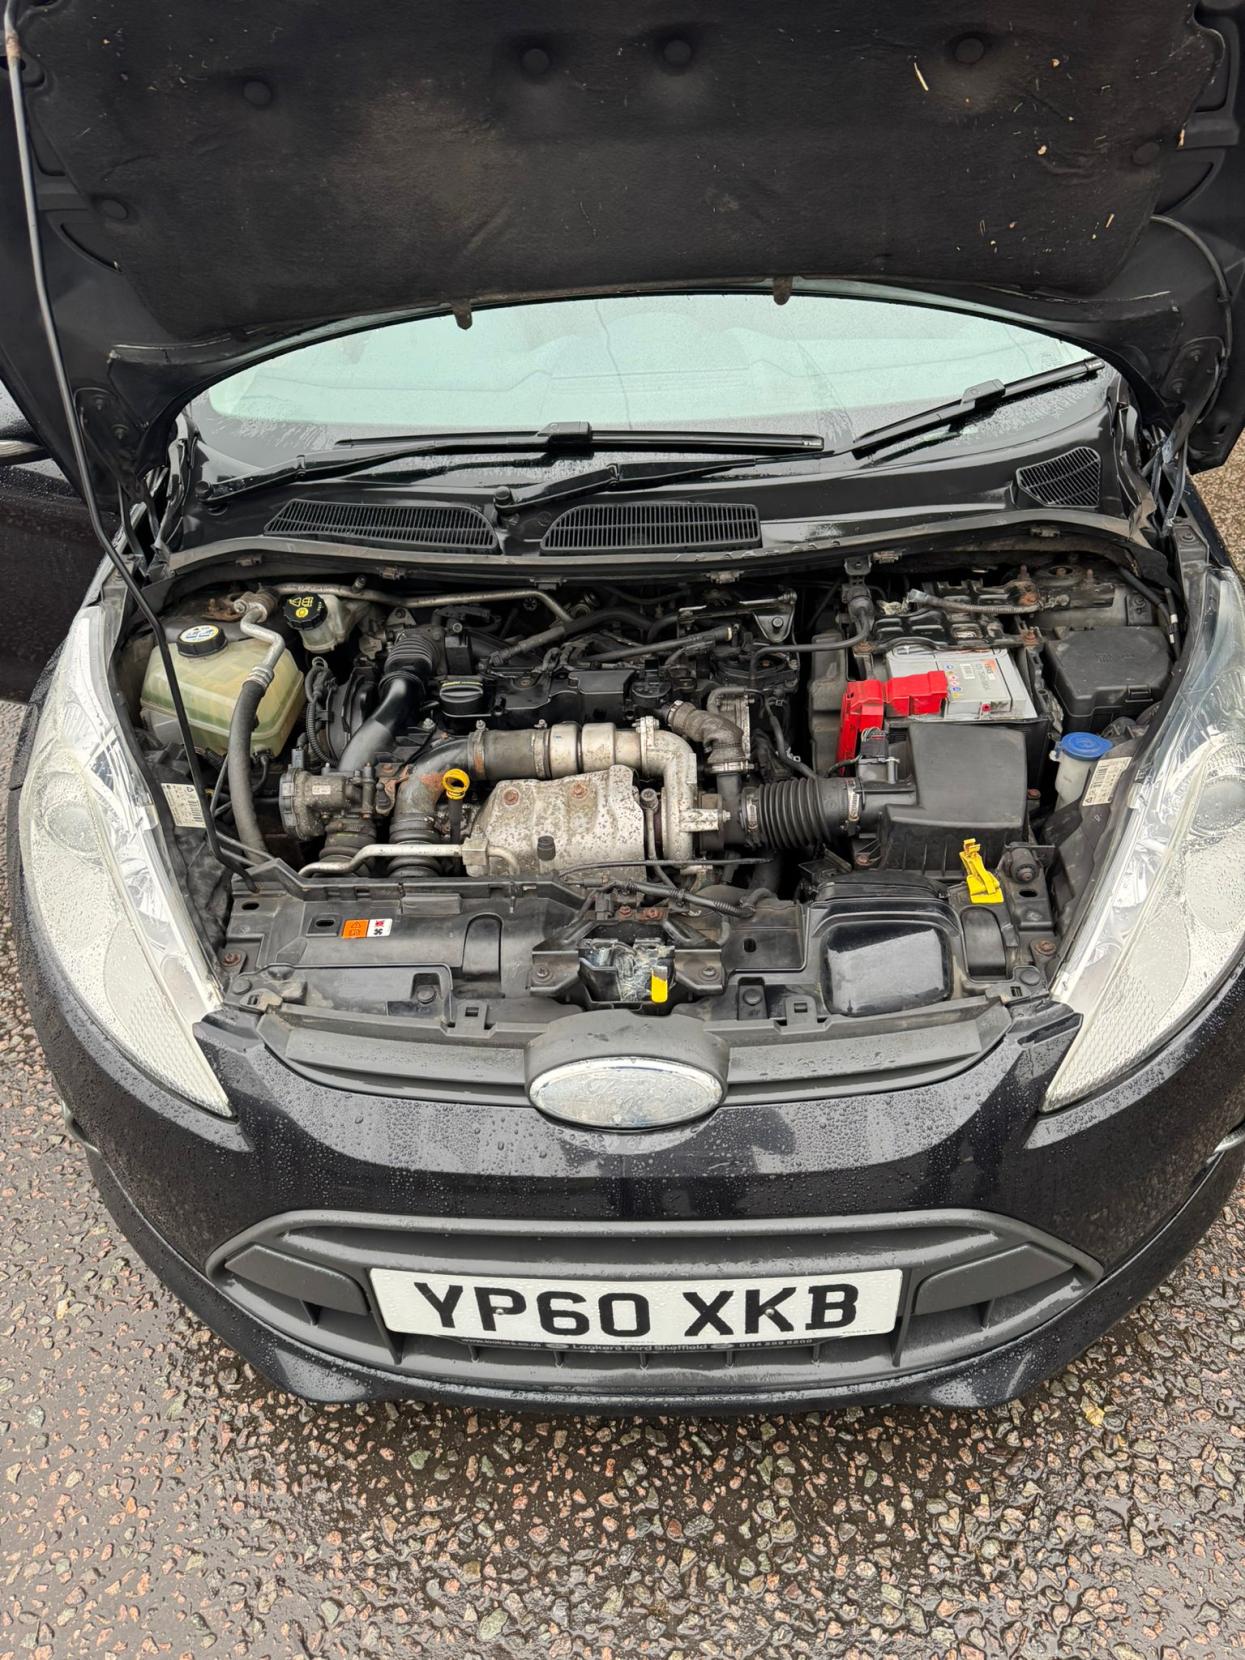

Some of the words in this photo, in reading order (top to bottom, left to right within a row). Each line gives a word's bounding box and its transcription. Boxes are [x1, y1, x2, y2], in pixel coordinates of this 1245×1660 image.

[414, 1282, 650, 1337] YP60
[682, 1283, 859, 1336] XKB
[654, 1343, 708, 1351] Sheffield
